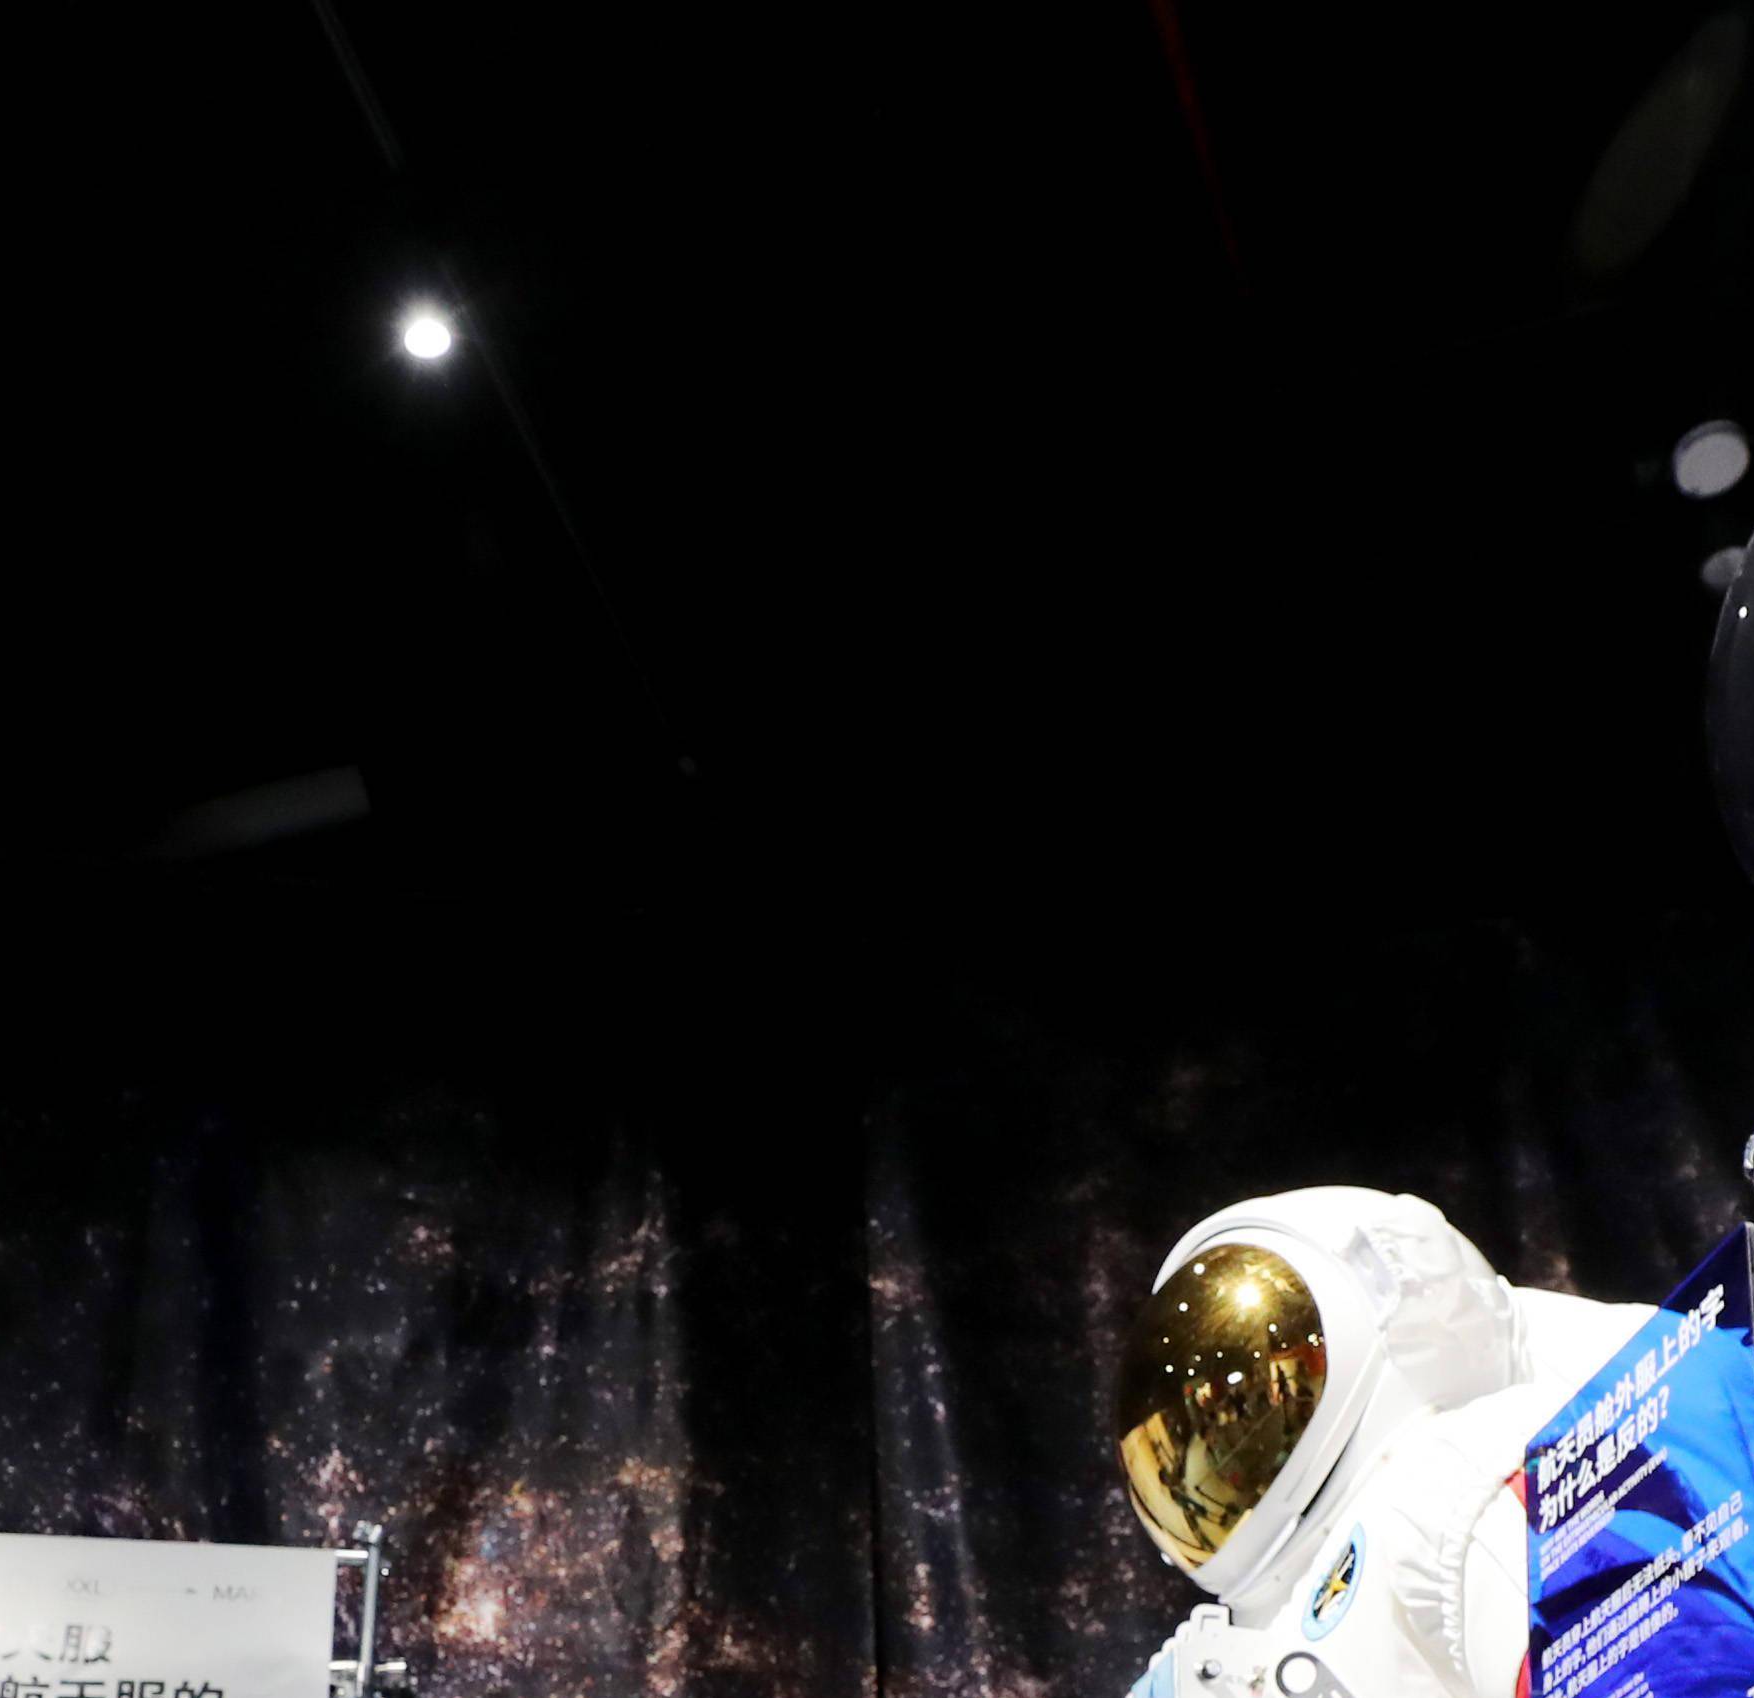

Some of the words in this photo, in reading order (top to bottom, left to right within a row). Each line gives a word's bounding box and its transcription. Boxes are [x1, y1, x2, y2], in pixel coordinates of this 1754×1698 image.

[1537, 1284, 1725, 1493] 航天员舱外服上的字
